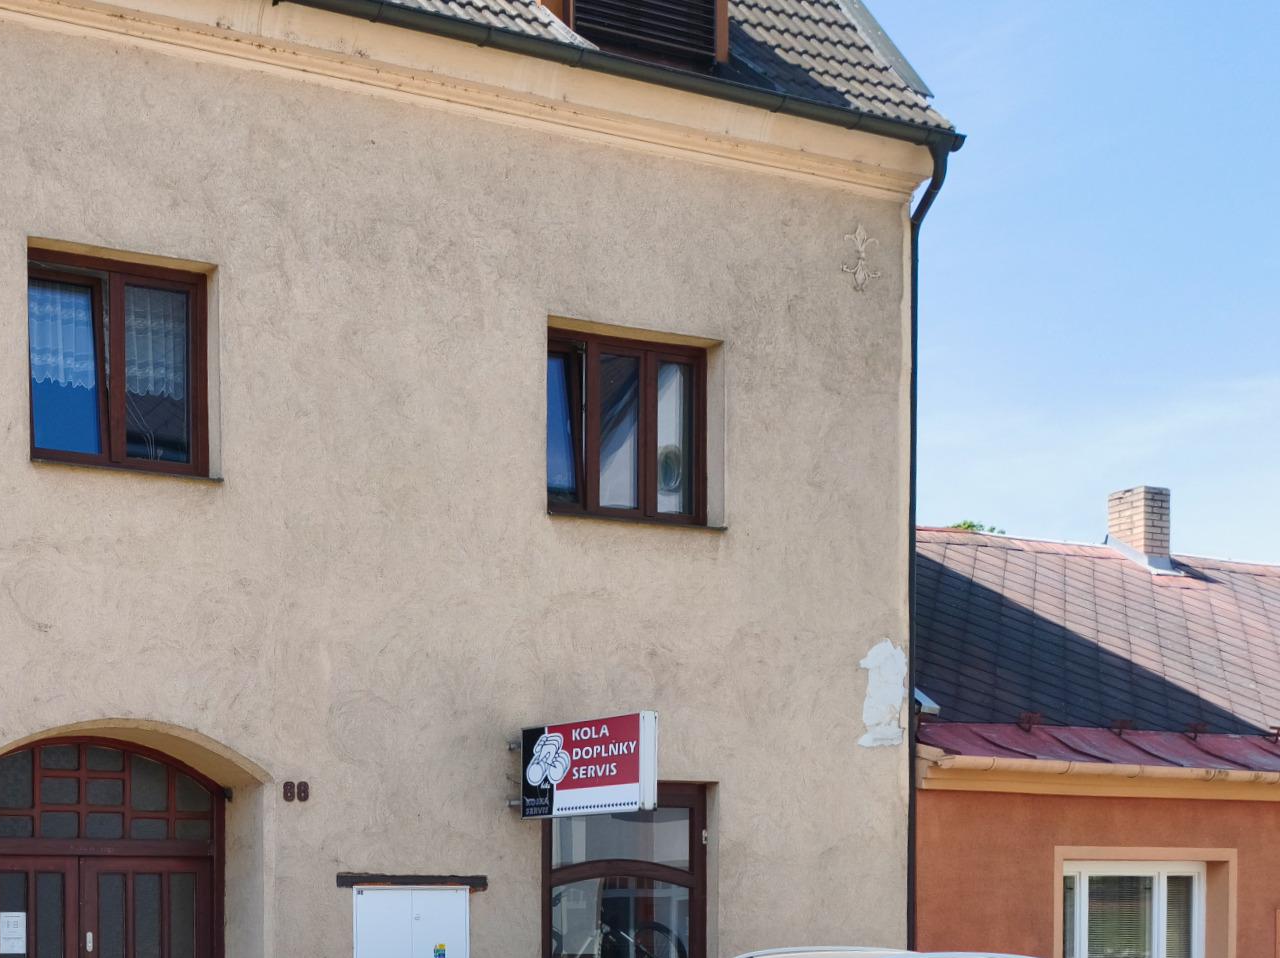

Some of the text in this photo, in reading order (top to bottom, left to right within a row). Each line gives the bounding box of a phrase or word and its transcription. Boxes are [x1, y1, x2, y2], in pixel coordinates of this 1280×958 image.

[572, 724, 610, 741] KOLA
[572, 740, 637, 760] DOPLŇKY
[572, 762, 618, 780] SERVIS
